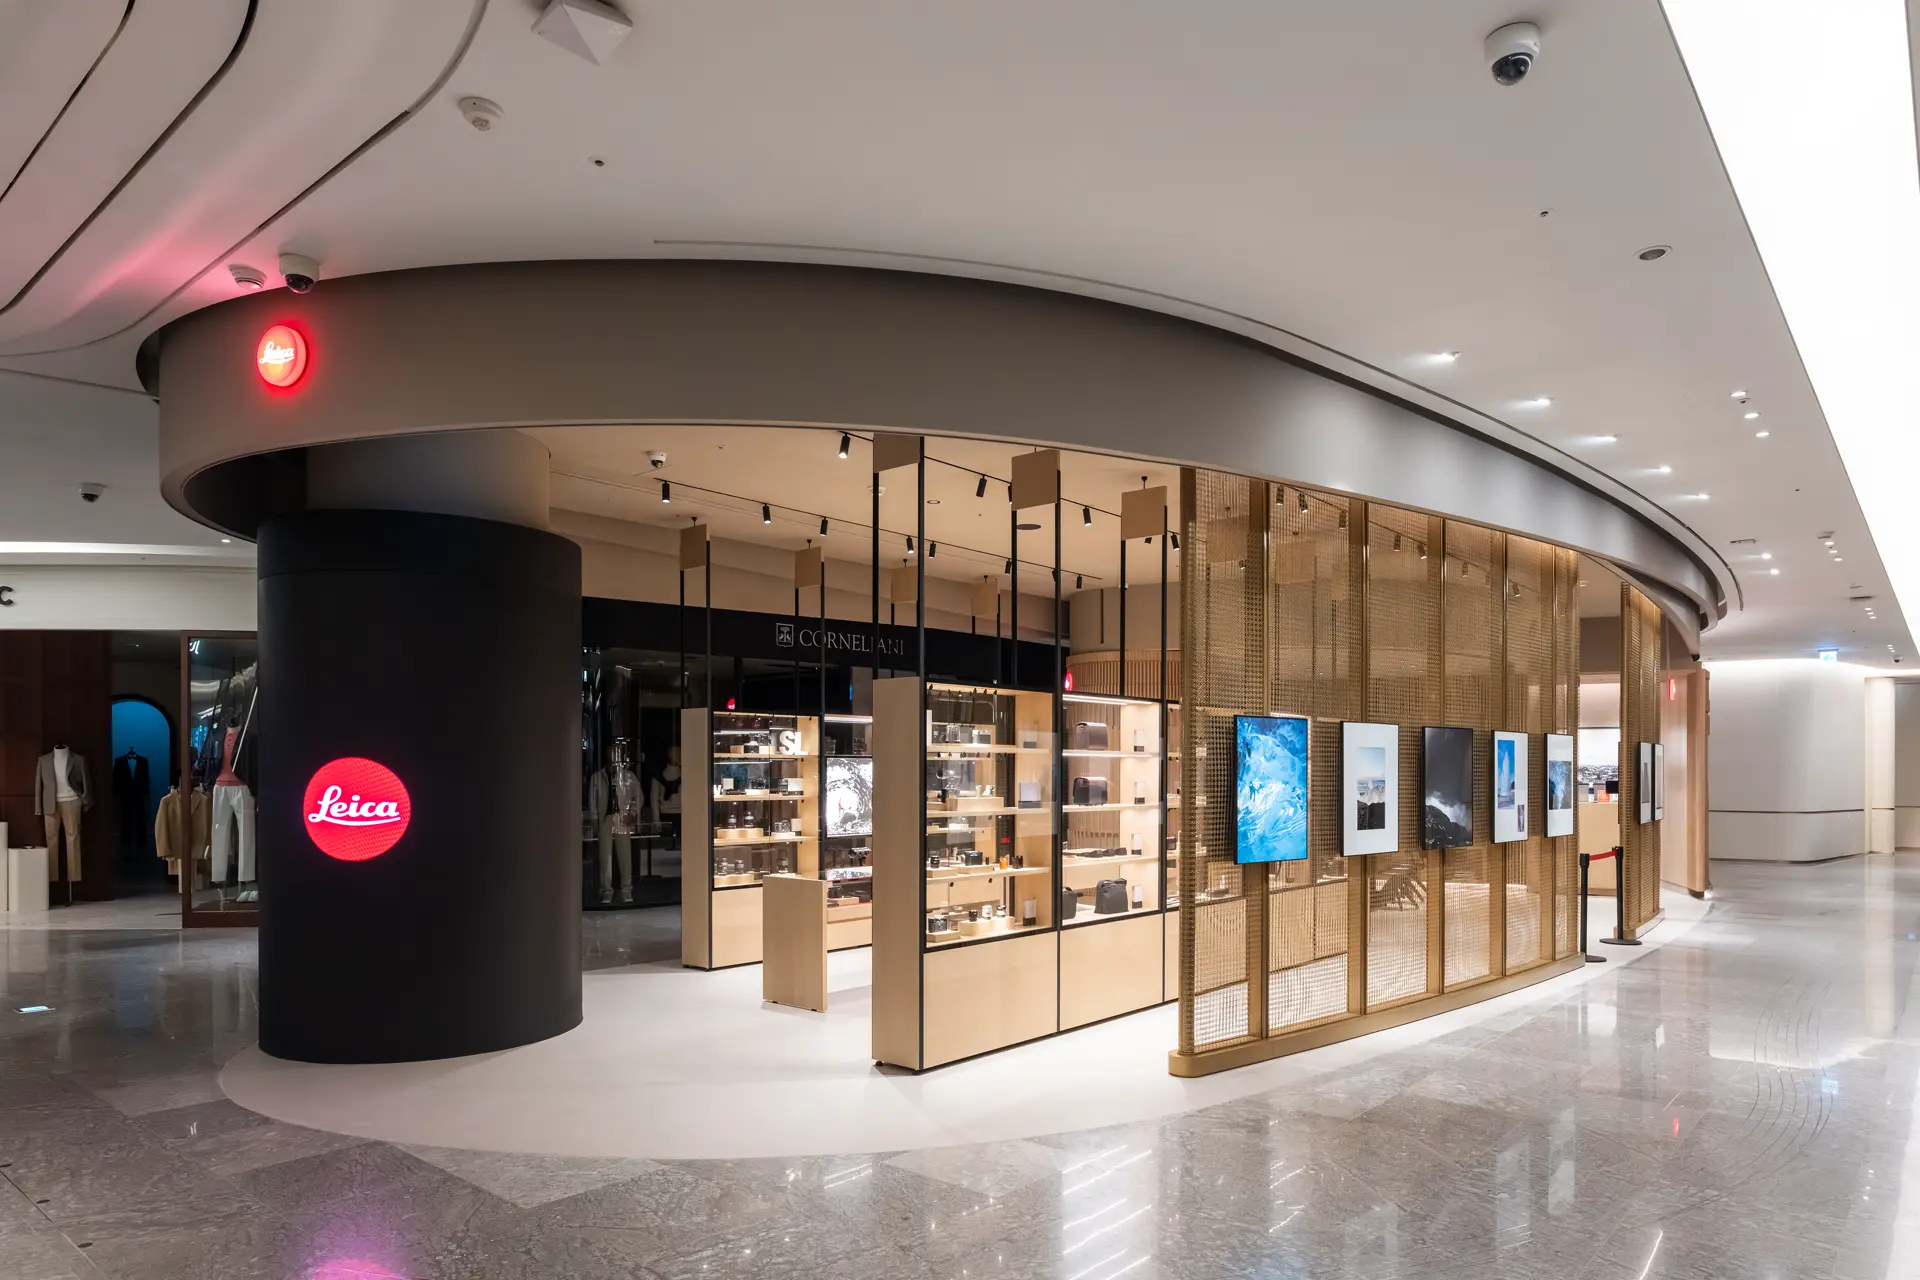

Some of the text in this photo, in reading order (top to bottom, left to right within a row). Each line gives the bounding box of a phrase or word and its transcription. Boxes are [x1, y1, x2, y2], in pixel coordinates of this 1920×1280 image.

[259, 341, 295, 364] Leica
[799, 628, 904, 655] CORNELIANI
[779, 730, 808, 755] SL
[308, 785, 401, 826] Leica
